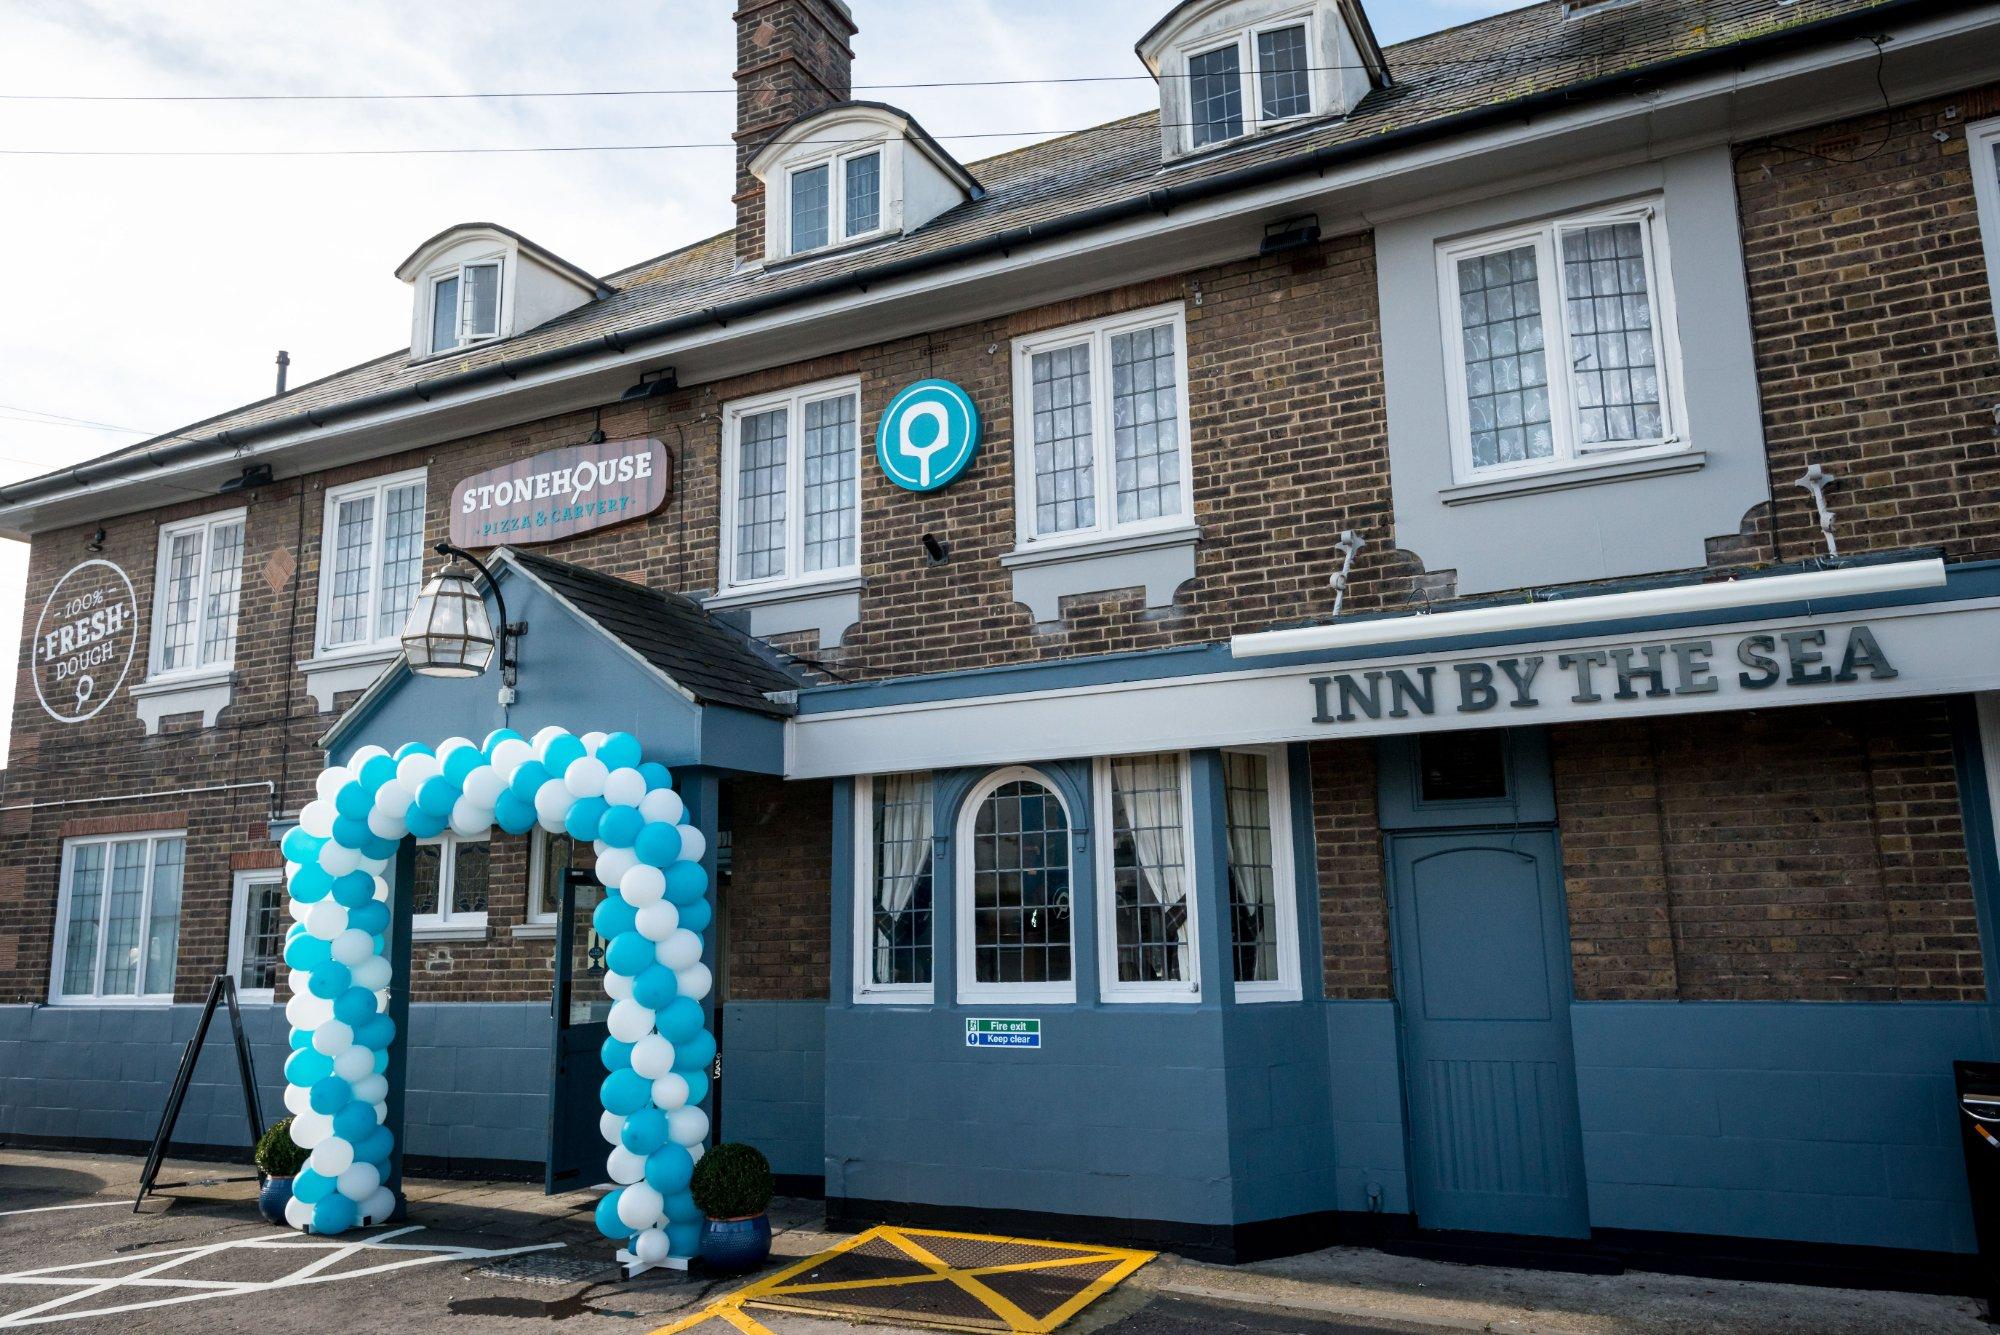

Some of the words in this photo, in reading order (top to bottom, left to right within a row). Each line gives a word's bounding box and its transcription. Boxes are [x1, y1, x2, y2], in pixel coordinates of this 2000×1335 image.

[462, 452, 652, 513] STONEHOUSE
[482, 513, 531, 536] PIZZA
[535, 510, 547, 527] &
[551, 496, 630, 525] CARVERY
[45, 602, 124, 661] FRESH
[56, 640, 114, 681] DOUGH
[1308, 666, 1437, 723] INN
[1453, 655, 1544, 713] BY
[1559, 640, 1719, 703] THE
[1737, 626, 1899, 690] SEA
[987, 1034, 1008, 1044] Keep
[1009, 1034, 1031, 1044] clear
[990, 1021, 1008, 1031] Fire
[1010, 1021, 1027, 1031] exit
